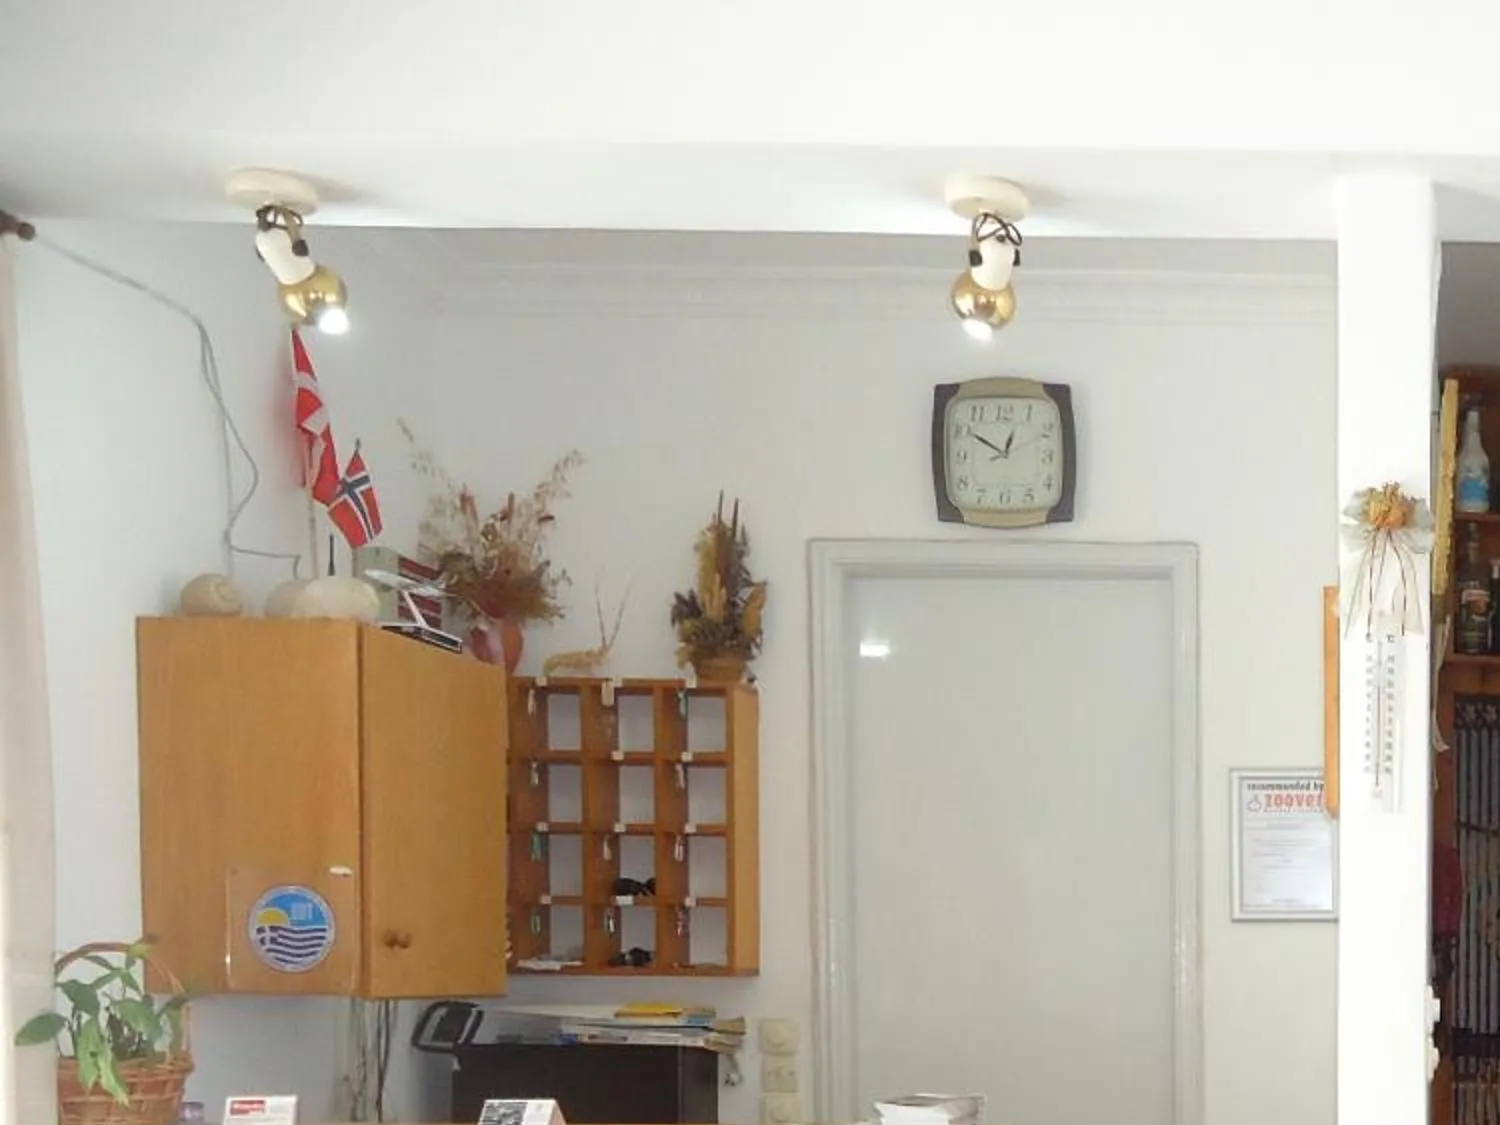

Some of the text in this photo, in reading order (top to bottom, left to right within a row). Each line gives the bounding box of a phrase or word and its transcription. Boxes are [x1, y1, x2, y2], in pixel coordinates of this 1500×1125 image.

[971, 404, 985, 422] 11
[995, 404, 1015, 422] 12
[1041, 422, 1054, 439] 2
[956, 450, 968, 465] 9
[1041, 449, 1054, 464] 3
[975, 488, 987, 505] 7
[1023, 487, 1036, 504] 5
